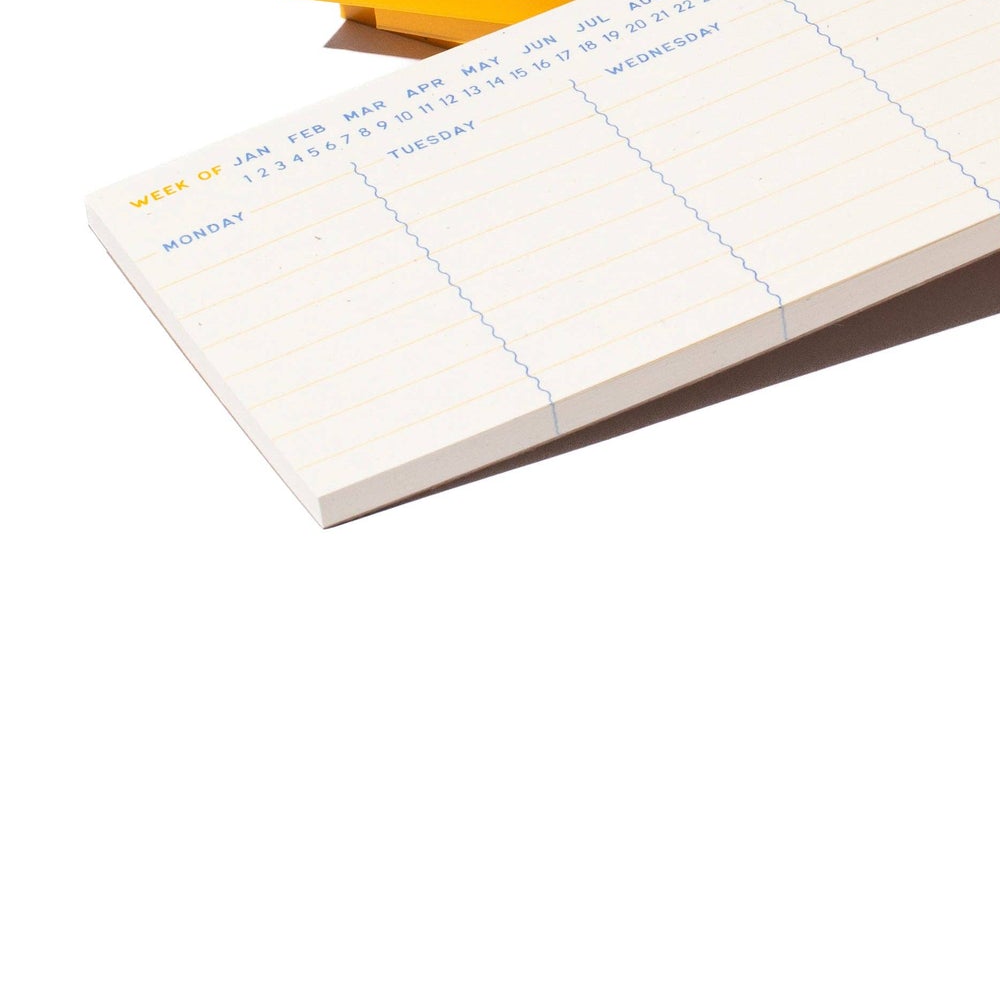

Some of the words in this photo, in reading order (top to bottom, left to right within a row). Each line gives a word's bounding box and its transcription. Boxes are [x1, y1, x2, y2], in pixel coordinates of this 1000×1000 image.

[604, 21, 722, 77] WEDNESDAY
[129, 179, 189, 209] WEEK
[197, 165, 222, 181] OF
[233, 145, 271, 166] JAN
[287, 124, 326, 144] FEB
[342, 100, 387, 122] MAR
[406, 78, 445, 99] APR
[461, 56, 499, 77] MAY
[522, 35, 558, 55] JUN
[576, 15, 610, 32] JUL
[243, 174, 252, 183] 1
[257, 168, 270, 178] 2
[274, 161, 286, 171] 3
[293, 154, 304, 162] 4
[306, 147, 320, 157] 5
[325, 141, 337, 151] 6
[340, 133, 349, 145] 7
[358, 127, 371, 137] 8
[376, 121, 387, 130] 9
[394, 111, 413, 123] 10
[418, 103, 434, 114] 11
[438, 94, 458, 106] 12
[462, 85, 482, 97] 13
[486, 76, 505, 88] 14
[509, 67, 528, 80] 15
[532, 59, 551, 71] 16
[555, 49, 570, 62] 17
[578, 40, 597, 52] 18
[602, 30, 619, 42] 19
[625, 19, 647, 33] 20
[650, 10, 670, 23] 21
[673, 0, 696, 13] 22
[386, 120, 475, 159] TUESDAY
[162, 211, 243, 252] MONDAY
